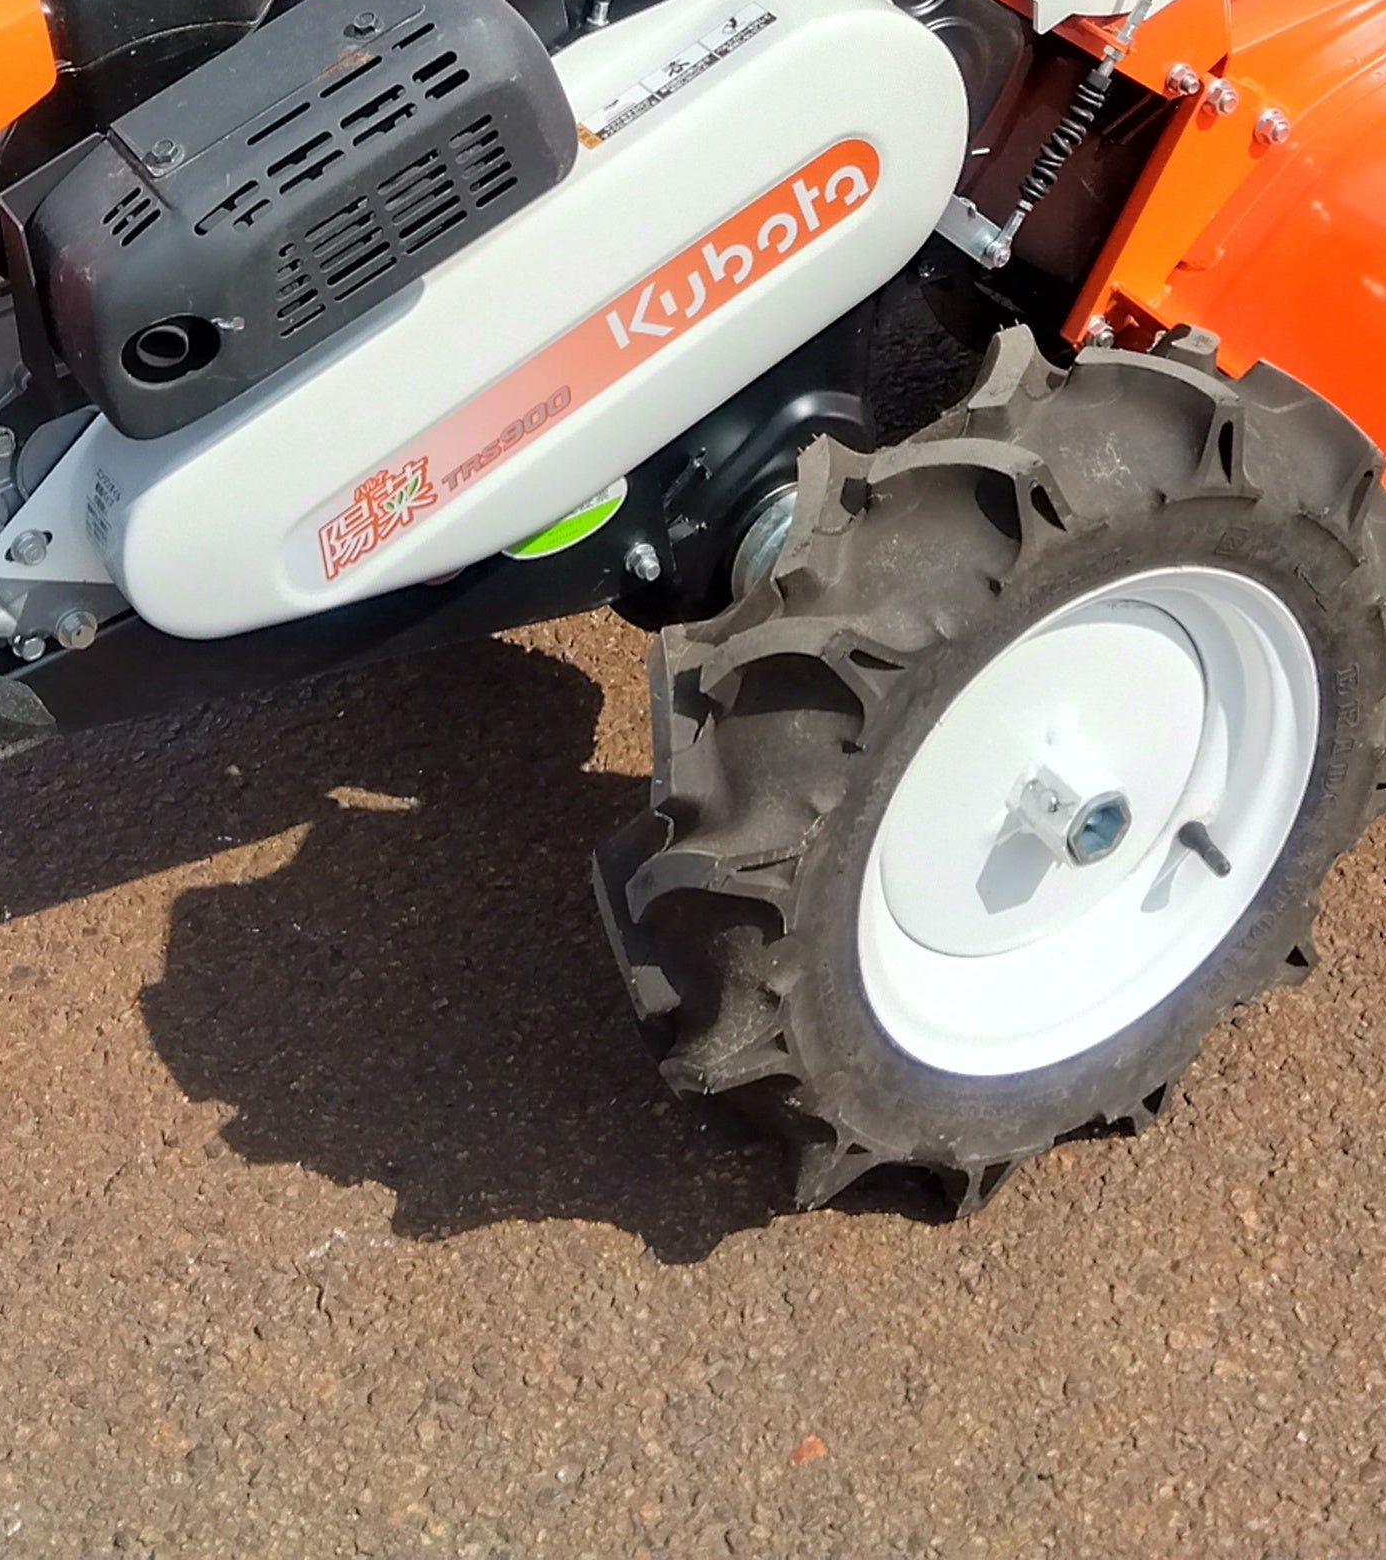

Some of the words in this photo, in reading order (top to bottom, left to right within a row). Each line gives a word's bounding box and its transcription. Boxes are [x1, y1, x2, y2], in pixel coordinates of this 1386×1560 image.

[605, 165, 869, 349] Kubota
[442, 385, 572, 491] TRS900
[318, 456, 438, 581] 陽菜
